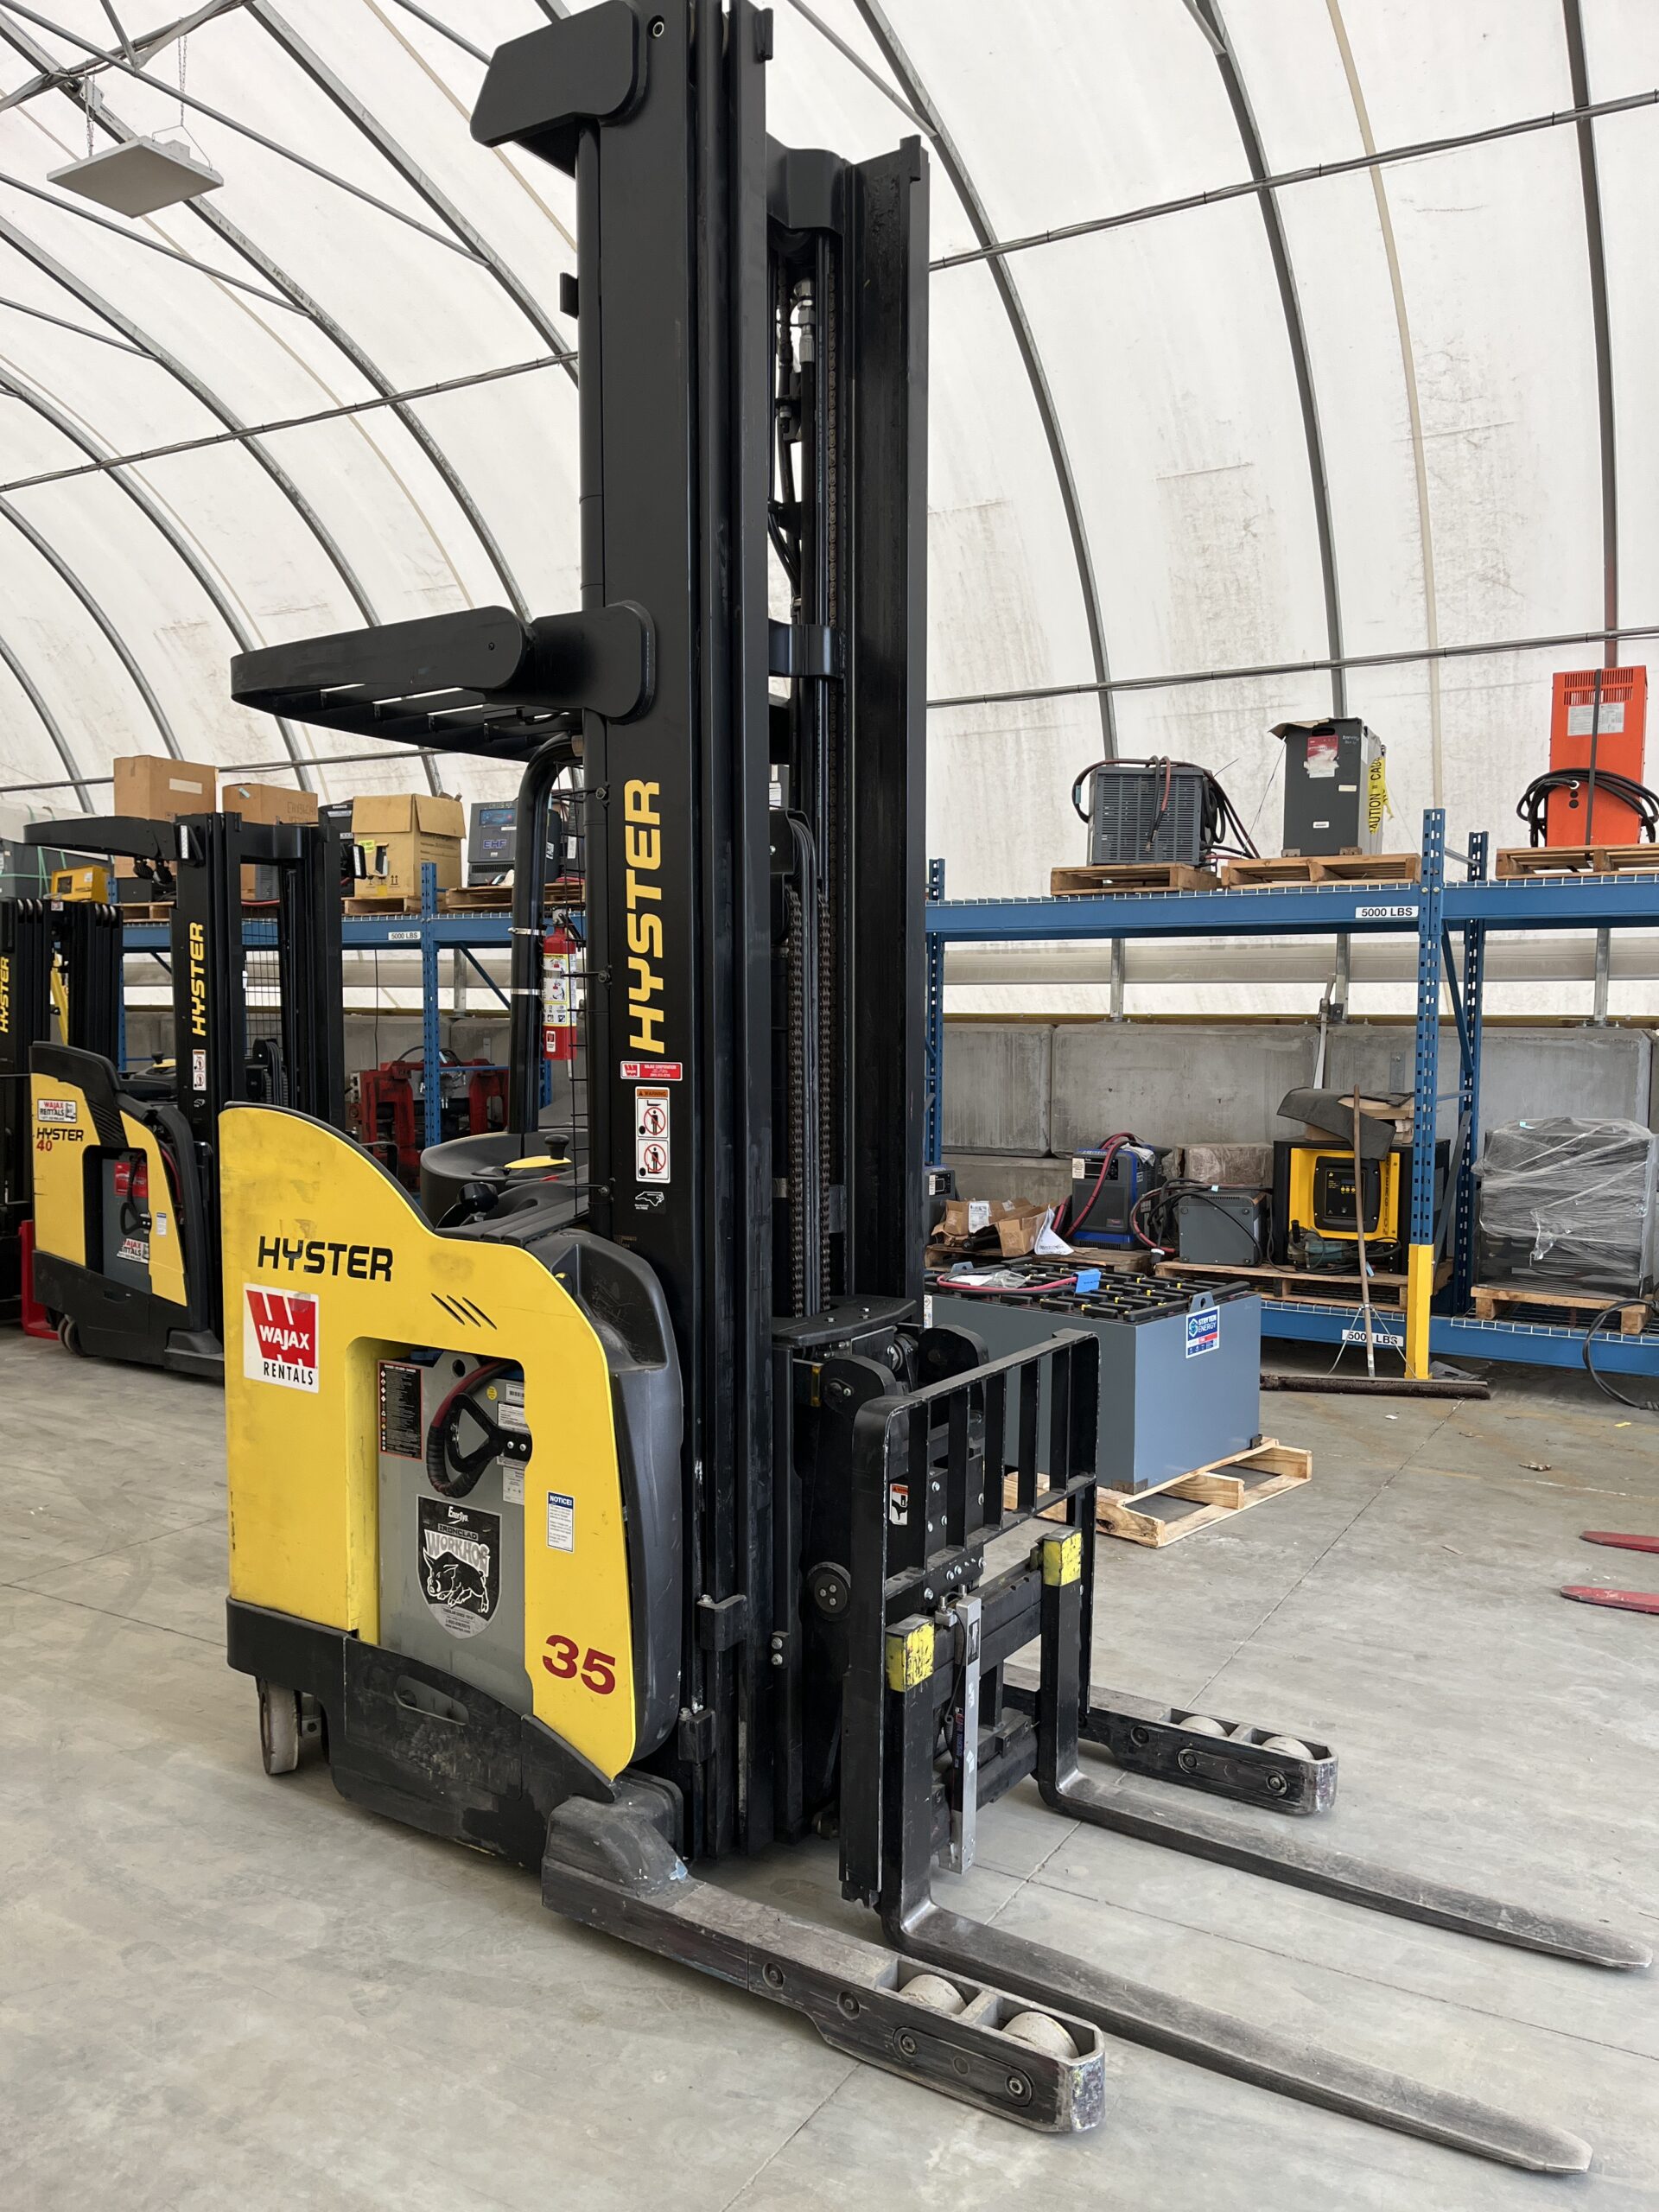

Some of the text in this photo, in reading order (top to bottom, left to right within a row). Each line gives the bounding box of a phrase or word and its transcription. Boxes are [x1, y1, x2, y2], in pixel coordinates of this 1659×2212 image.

[484, 839, 507, 849] EHF
[624, 779, 664, 1054] HYSTER
[1362, 907, 1413, 917] 5000 LBS
[189, 922, 207, 1037] HYSTER
[0, 957, 9, 1033] HYSTER
[40, 1108, 64, 1116] RENTALS
[36, 1127, 84, 1141] HYSTER
[36, 1140, 53, 1151] 40
[257, 1236, 393, 1282] HYSTER
[259, 1325, 309, 1351] WAJAX
[1348, 1332, 1398, 1344] 500 LBS
[264, 1361, 314, 1386] RENTALS
[550, 1495, 573, 1506] NOTICE!
[439, 1524, 478, 1540] IRONCLAD
[424, 1529, 490, 1577] WORKHOG
[543, 1635, 615, 1694] 35
